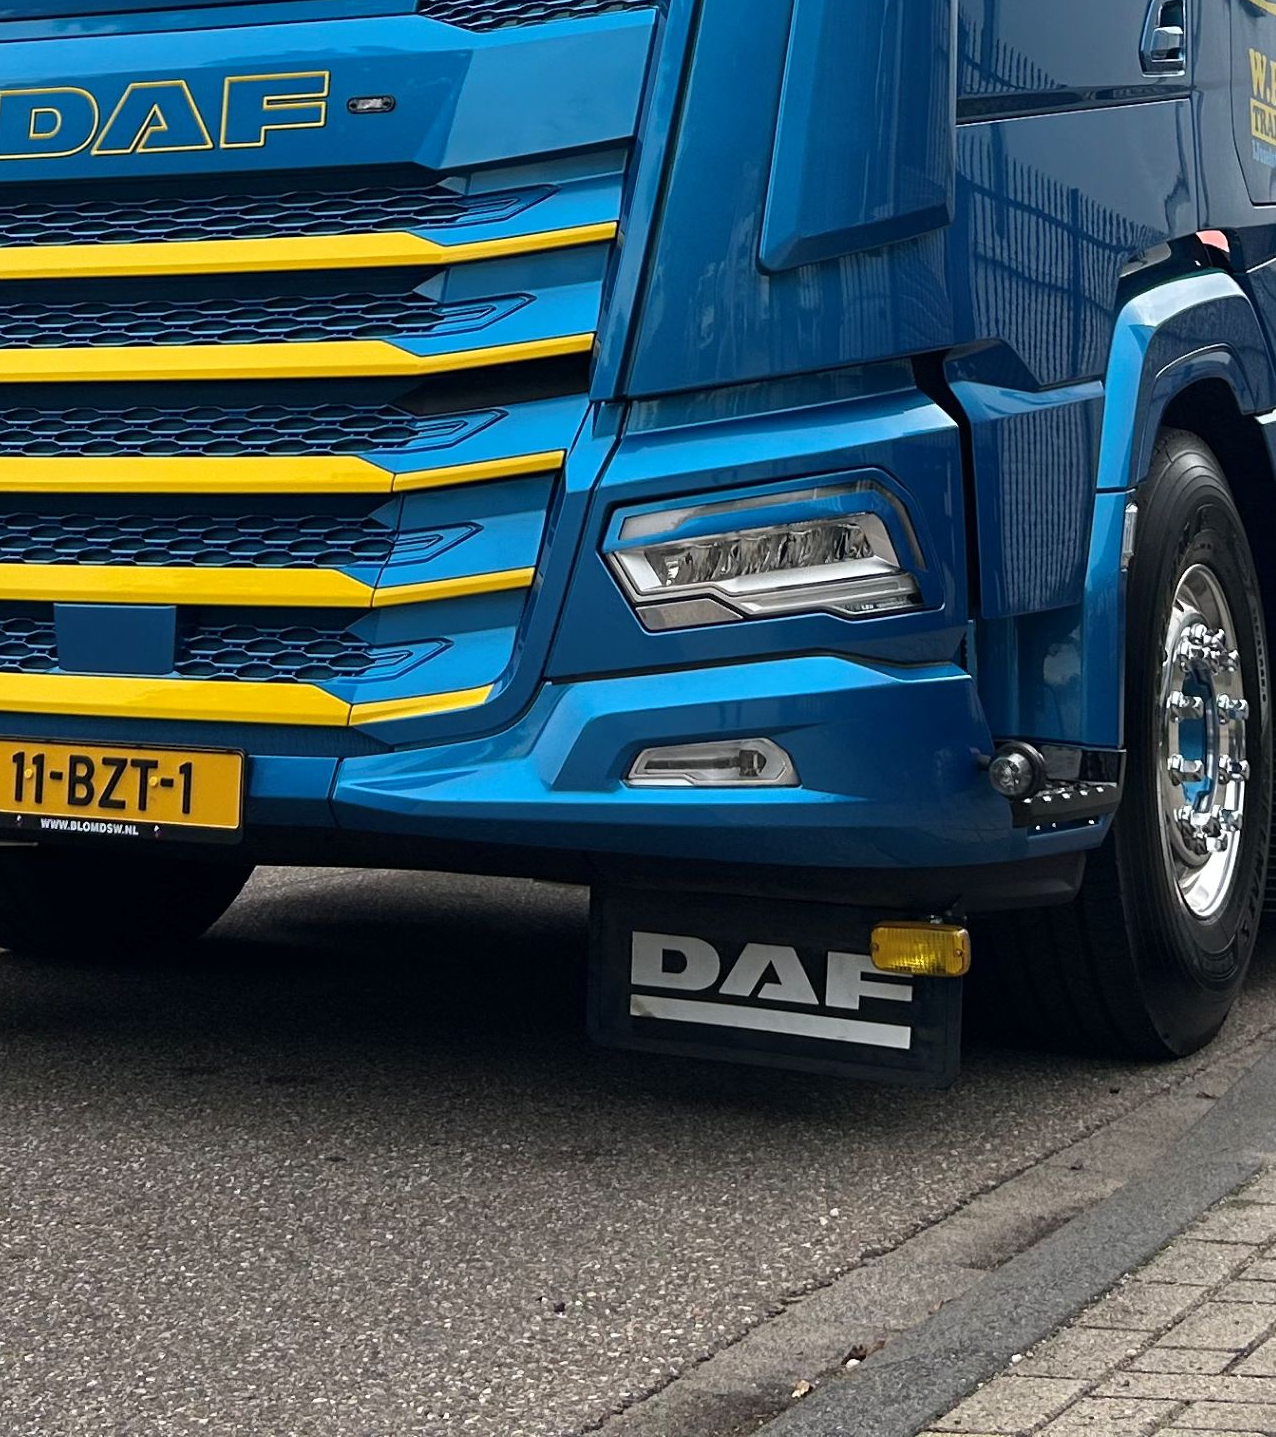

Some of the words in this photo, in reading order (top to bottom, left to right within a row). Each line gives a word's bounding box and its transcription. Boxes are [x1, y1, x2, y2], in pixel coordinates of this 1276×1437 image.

[11, 751, 193, 815] 11-BZT-1
[39, 817, 140, 837] WWW.BLOMDSW.NL
[630, 930, 914, 1011] DAF
